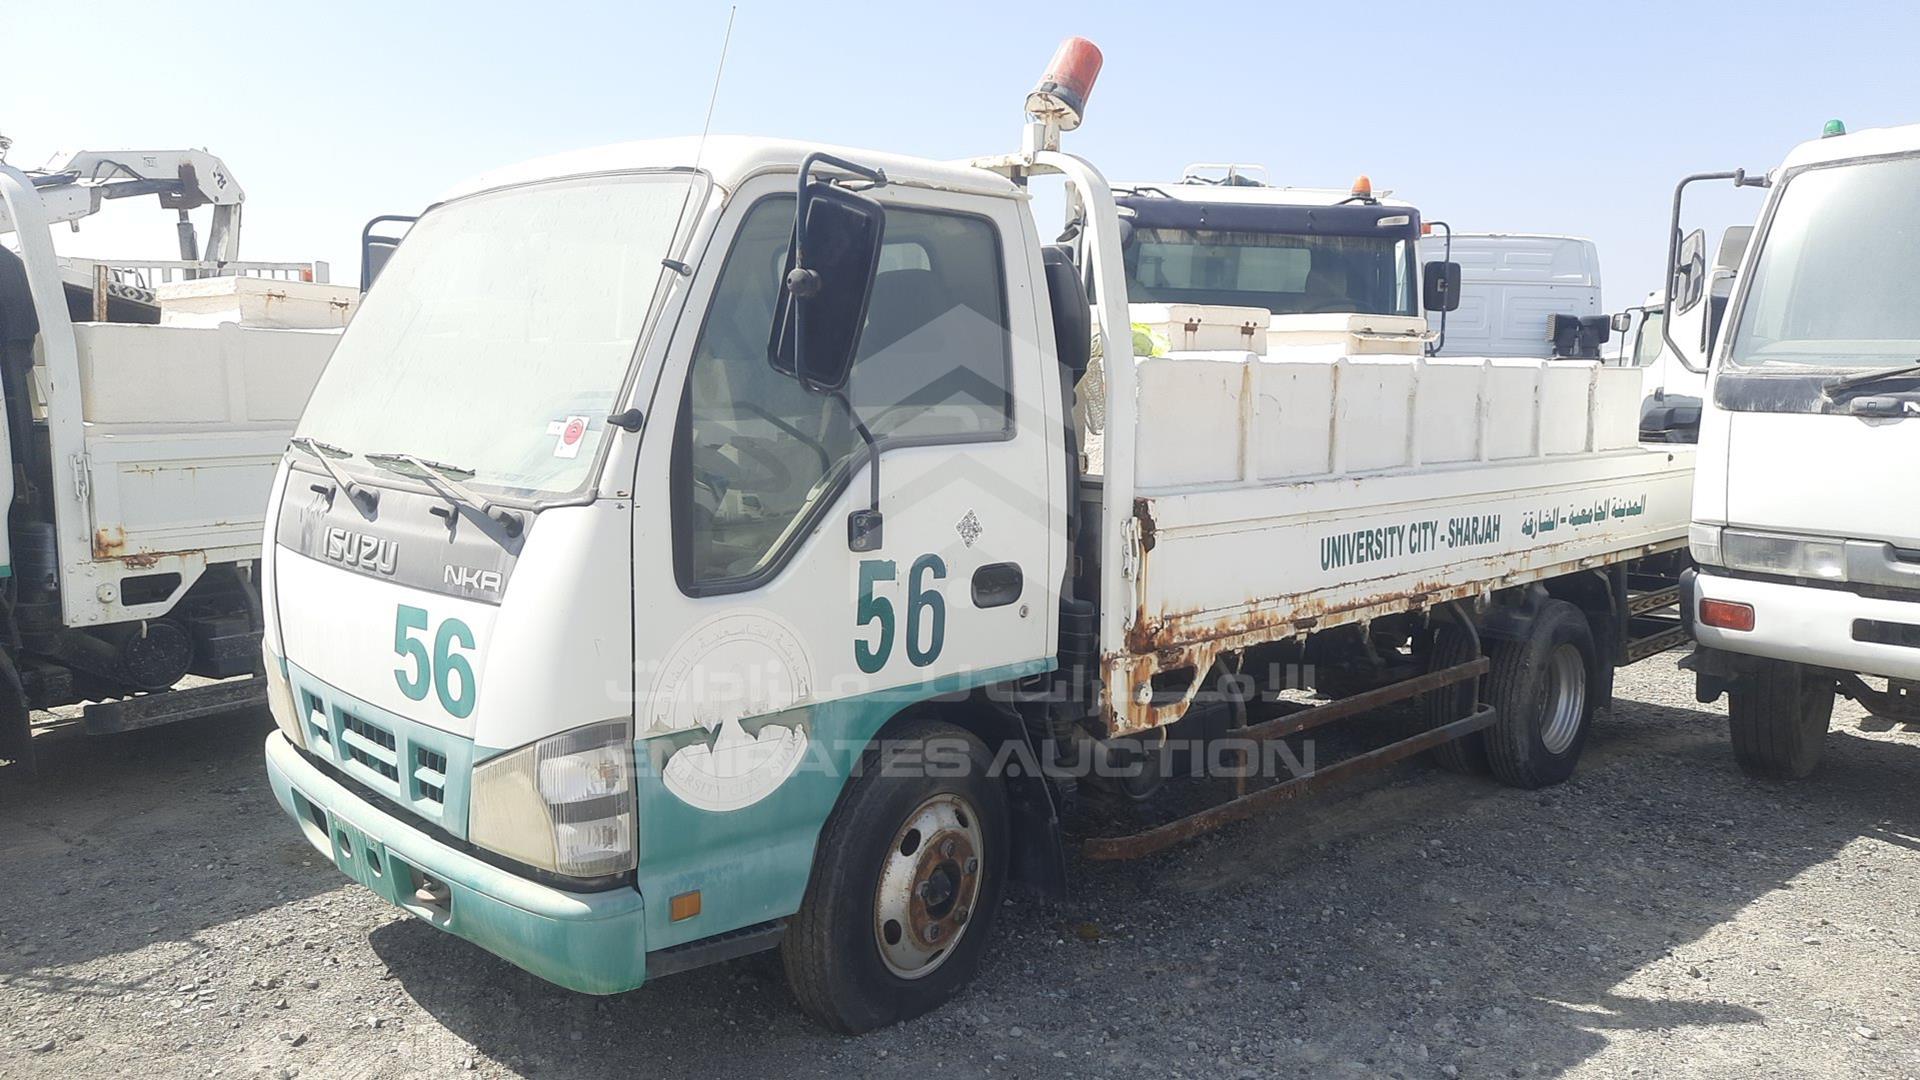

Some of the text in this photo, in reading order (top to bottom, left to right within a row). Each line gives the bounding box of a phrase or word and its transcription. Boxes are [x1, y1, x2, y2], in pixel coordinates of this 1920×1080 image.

[1521, 506, 1559, 539] الشارقة
[1568, 498, 1610, 532] الجامعية
[1611, 493, 1647, 524] المدينة
[322, 526, 399, 575] ISUZU
[1320, 524, 1406, 571] UNIVERSITY
[1409, 520, 1439, 554] CITY
[1447, 514, 1502, 549] SHARJAH
[443, 564, 504, 592] NKR
[854, 553, 947, 675] 56
[393, 603, 476, 719] 56
